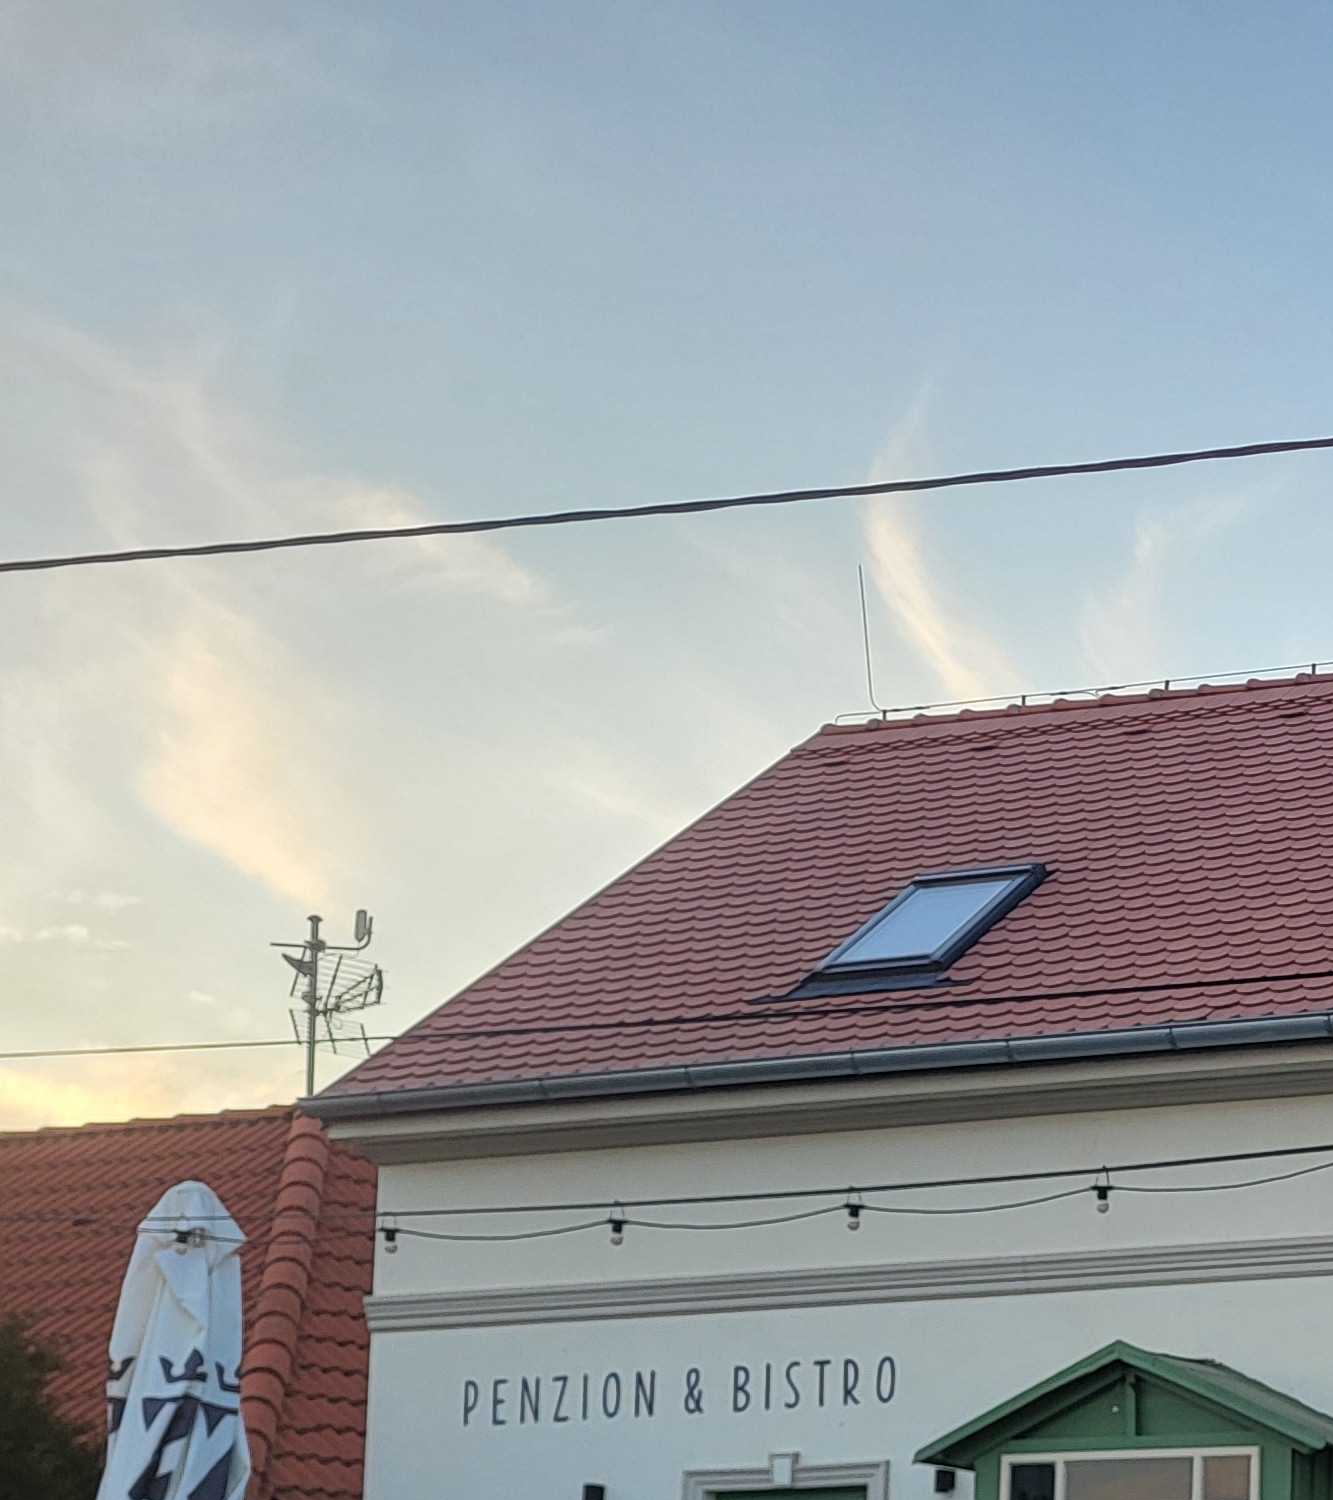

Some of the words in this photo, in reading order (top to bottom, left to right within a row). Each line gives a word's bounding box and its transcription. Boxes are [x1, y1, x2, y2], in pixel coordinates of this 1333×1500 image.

[462, 1368, 658, 1427] PENZION
[683, 1367, 705, 1415] &
[731, 1355, 898, 1413] BISTRO
